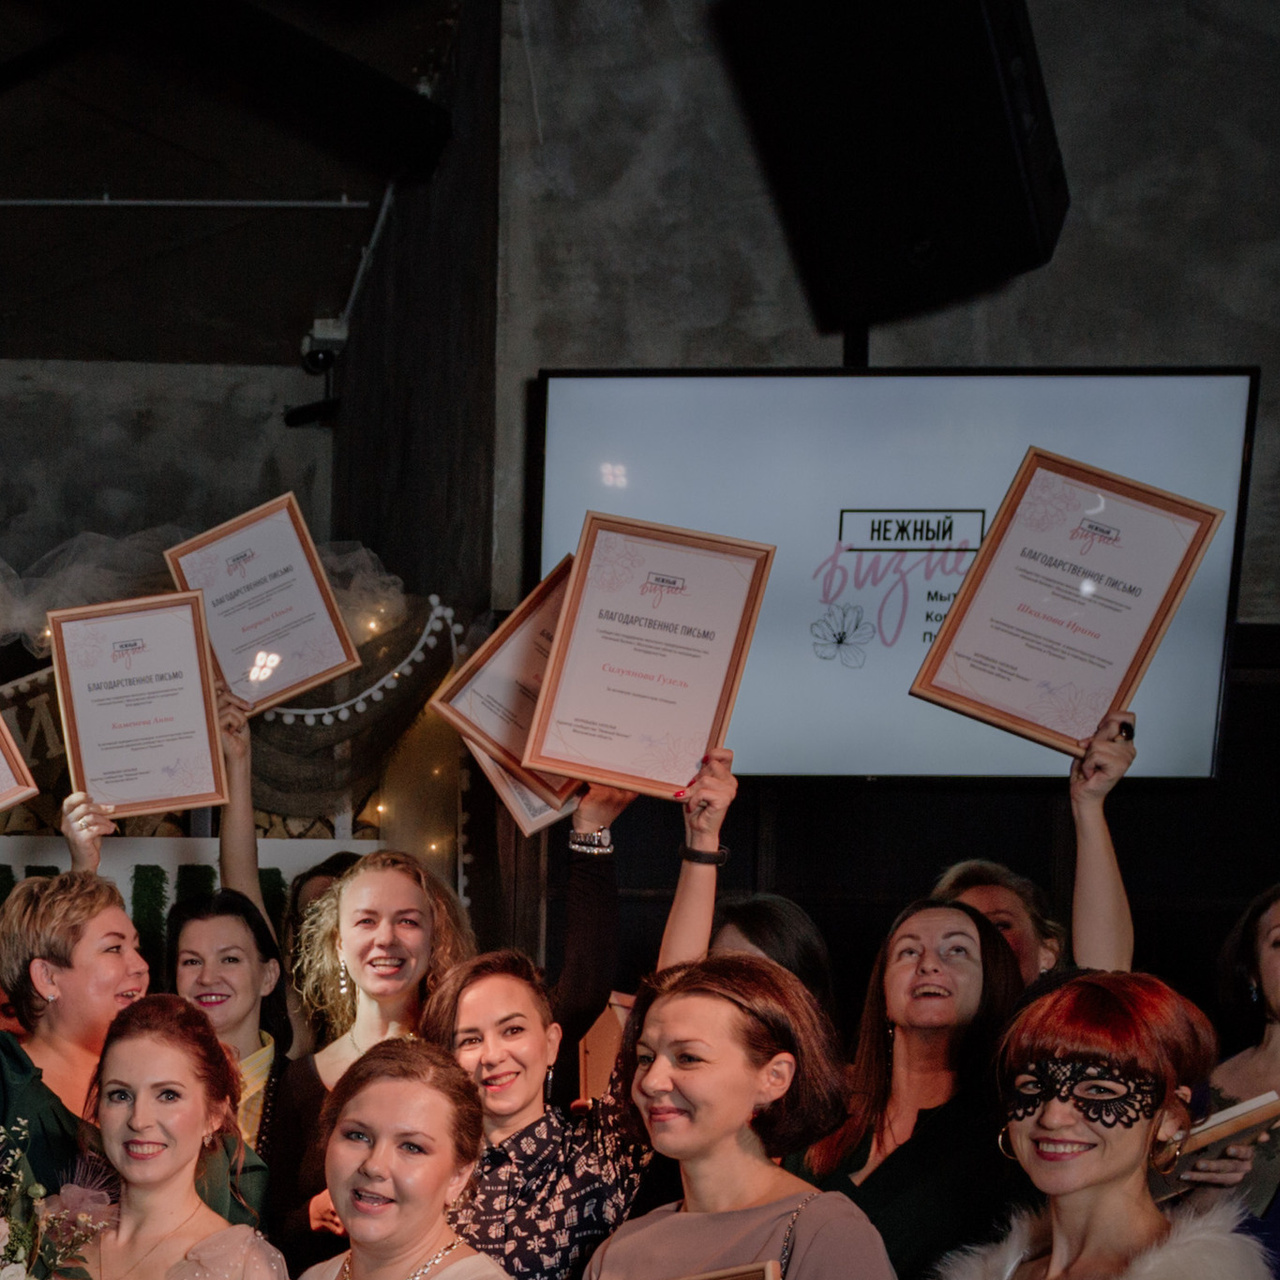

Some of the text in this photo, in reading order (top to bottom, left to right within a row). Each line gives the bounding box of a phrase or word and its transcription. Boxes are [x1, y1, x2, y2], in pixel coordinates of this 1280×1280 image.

[871, 515, 953, 541] НЕЖНЫЙ
[1020, 547, 1104, 583] БЛАГОДАРСТВЕННОЕ
[1105, 577, 1142, 597] ПИСЬМО
[927, 591, 956, 602] Мыт
[598, 609, 715, 641] БЛАГОДАРСТВЕННОЕ ПИСЬМО
[1066, 619, 1101, 640] Ирина
[87, 671, 183, 691] БЛАГОДАРСТВЕННОЕ ПИСЬМО
[657, 675, 688, 688] Гузель
